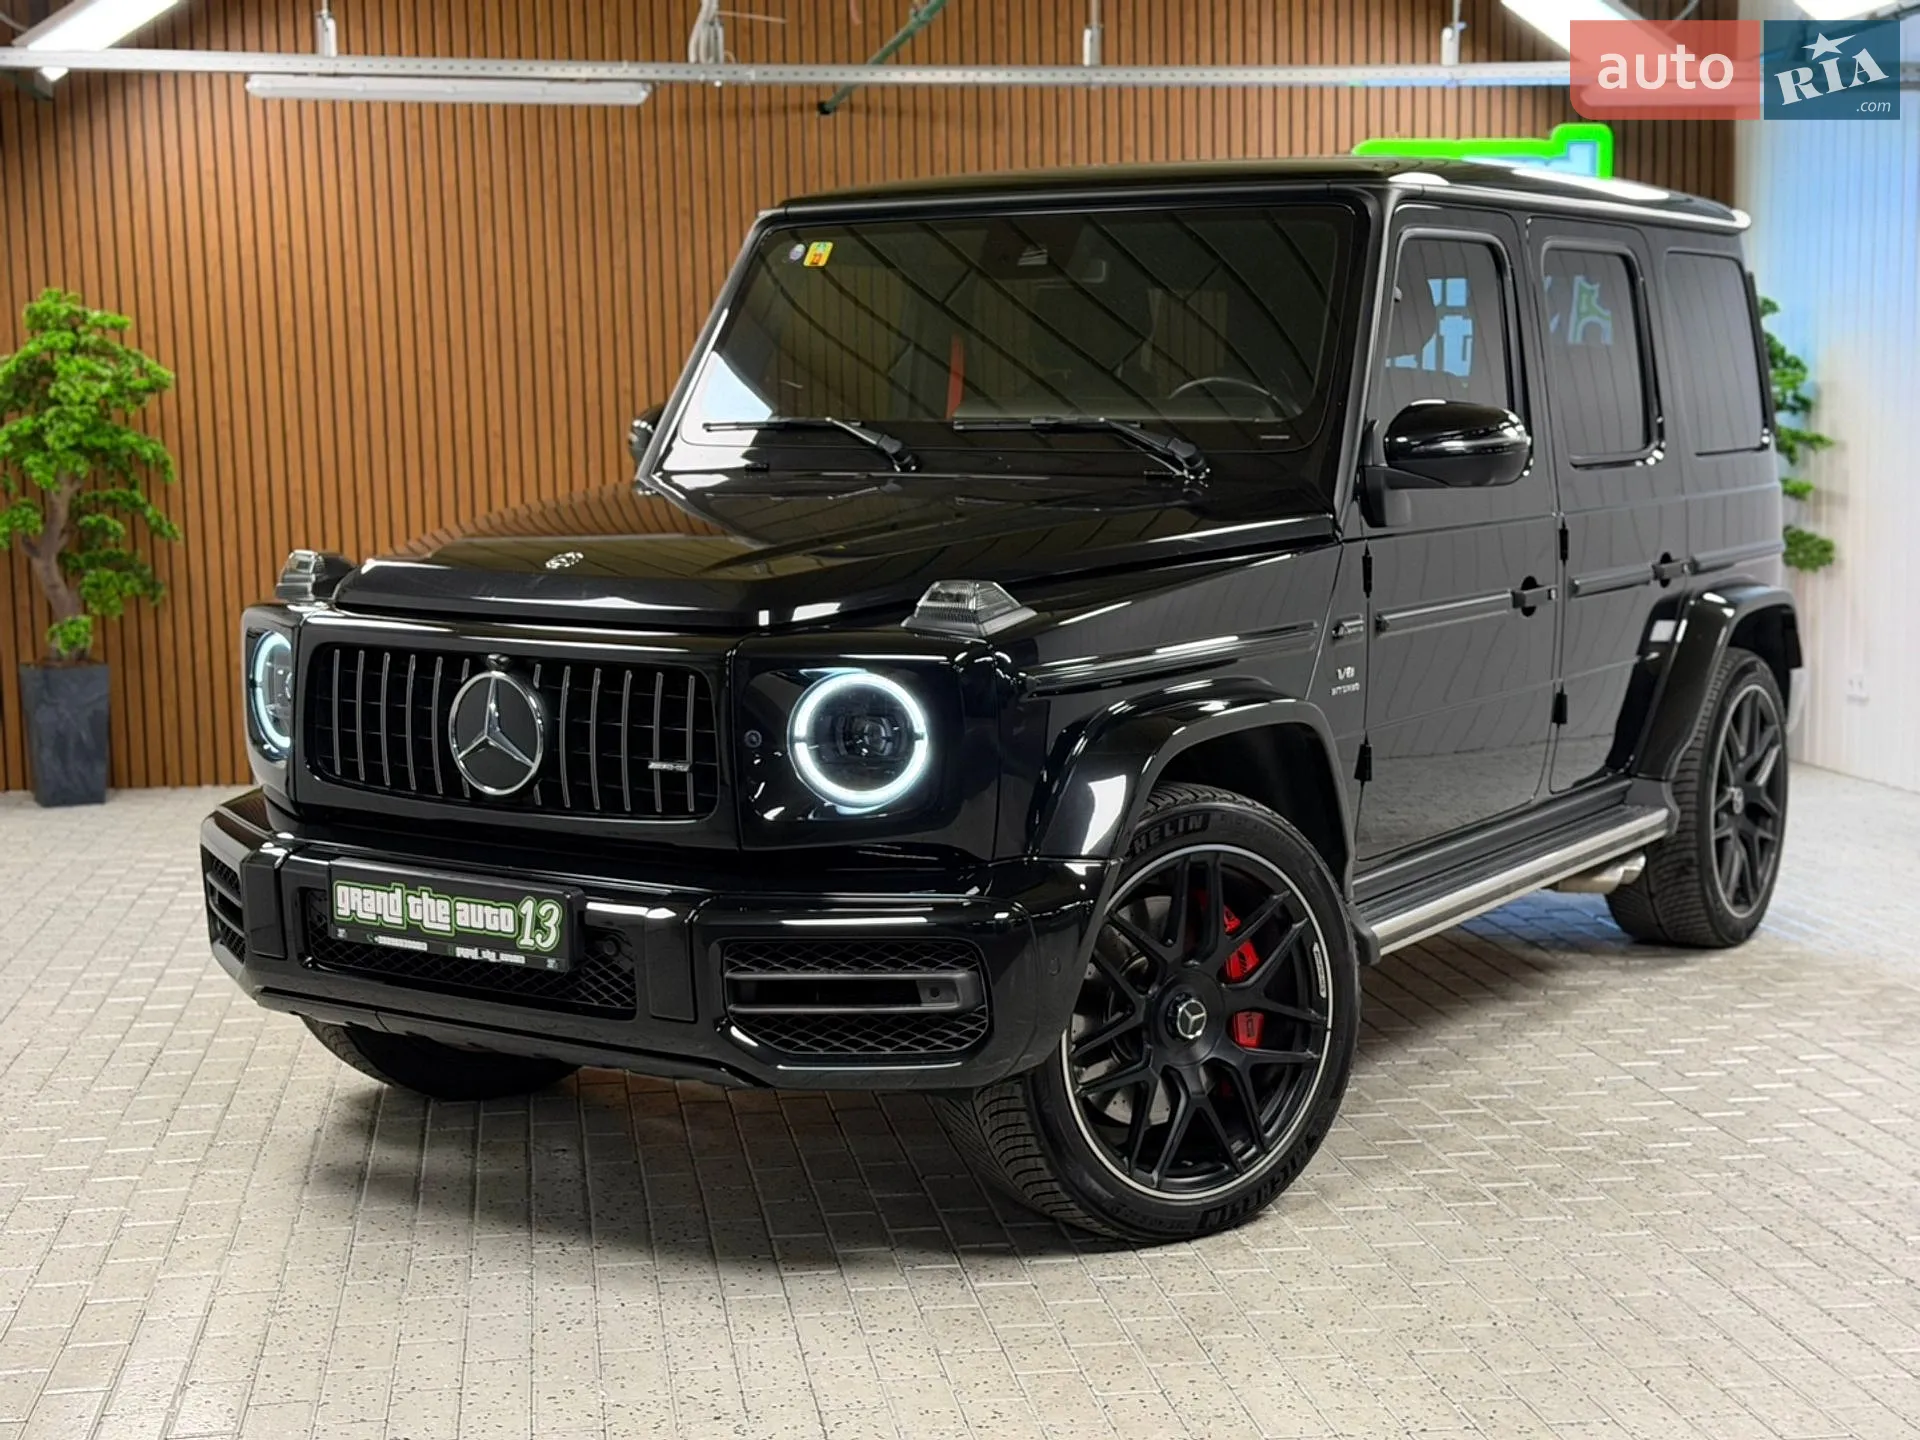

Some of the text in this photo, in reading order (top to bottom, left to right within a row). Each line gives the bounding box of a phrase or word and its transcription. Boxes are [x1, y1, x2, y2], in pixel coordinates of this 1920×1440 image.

[1132, 814, 1204, 855] HELIN
[335, 883, 562, 950] grand the auto 13
